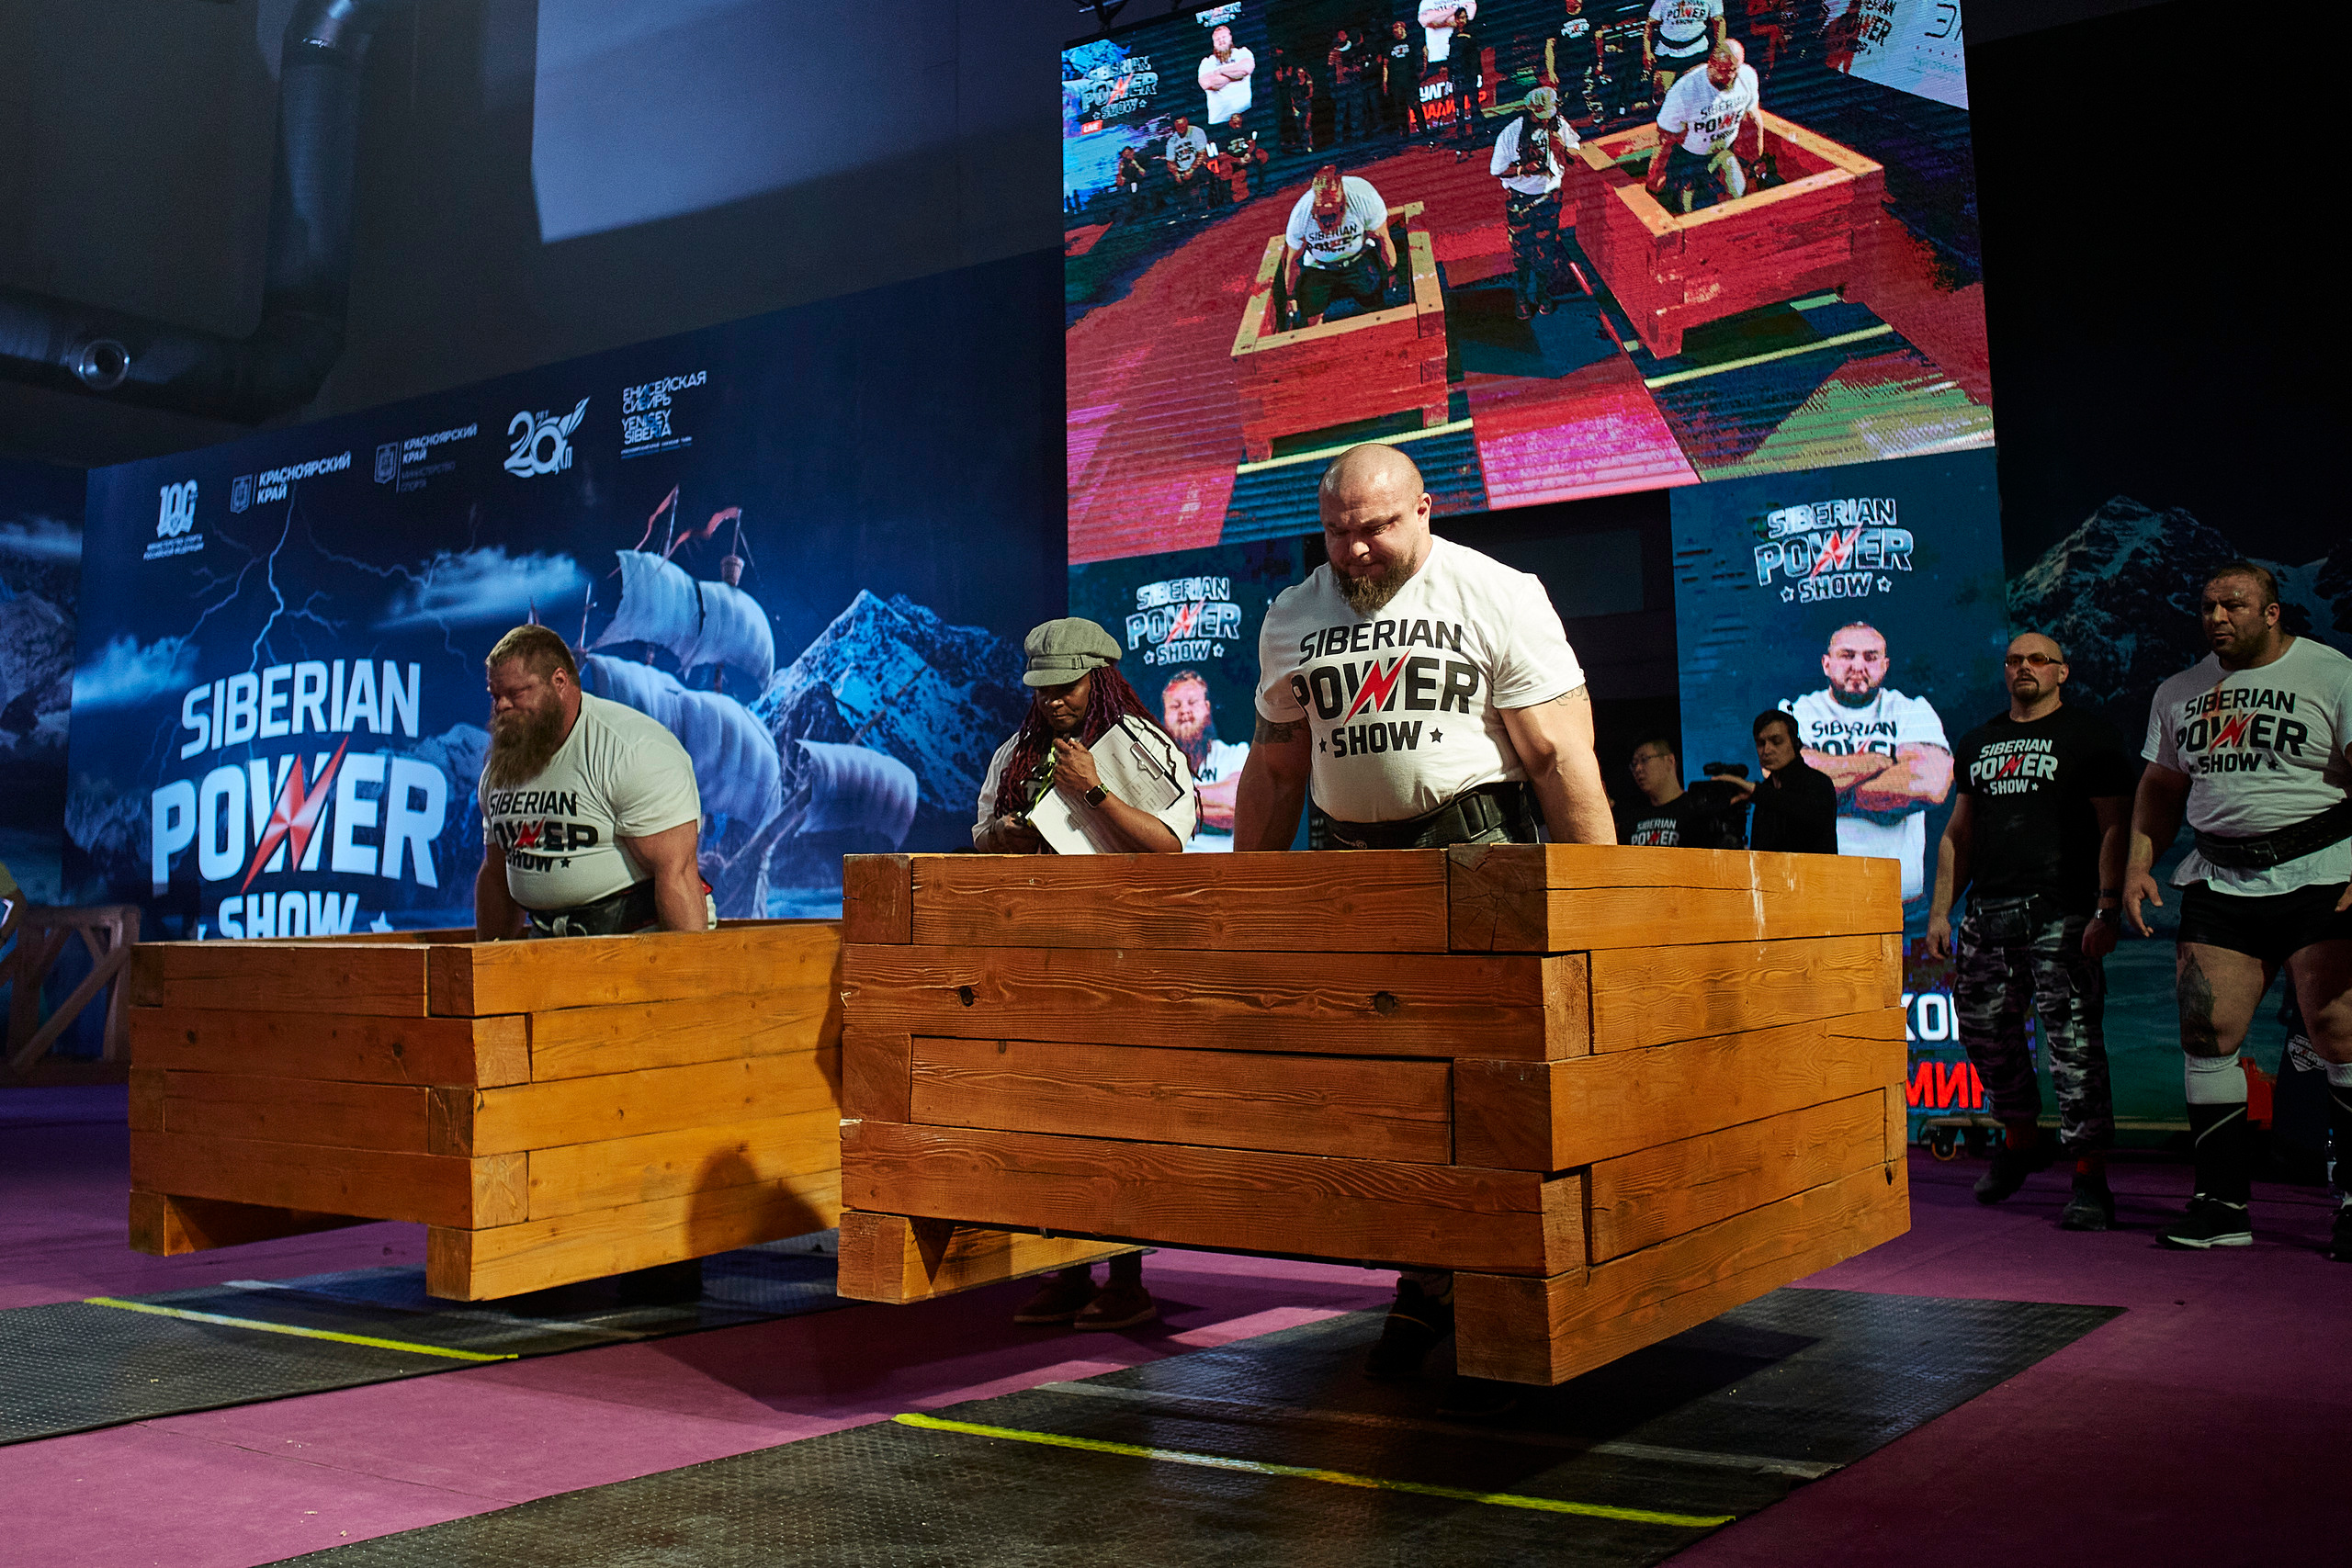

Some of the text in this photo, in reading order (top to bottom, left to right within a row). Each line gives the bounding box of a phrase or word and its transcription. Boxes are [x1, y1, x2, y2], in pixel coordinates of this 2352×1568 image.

[1080, 72, 1159, 112] POWER
[622, 370, 707, 402] ЕНИСЕЙСКАЯ
[623, 391, 673, 415] СИБИРЬ
[403, 423, 478, 452] КРАСНОЯРСКИЙ
[621, 409, 673, 432] YENISEY
[624, 423, 673, 446] SIBERIA
[258, 450, 352, 488] КРАСНОЯРСКИЙ
[402, 447, 427, 466] КРАЙ
[256, 482, 288, 505] КРАЙ
[1767, 498, 1898, 539] SIBERIAN
[1753, 526, 1914, 587] POWER
[1136, 576, 1230, 611] SIBERIAN
[1798, 571, 1873, 604] SHOW
[1125, 600, 1241, 651] POWER
[1299, 618, 1463, 666] SIBERIAN
[1156, 640, 1212, 666] SHOW
[1290, 652, 1479, 722] POWER
[2184, 687, 2296, 721] SIBERIAN
[180, 658, 422, 761] SIBERIAN
[1333, 720, 1423, 759] SHOW
[1980, 739, 2052, 759] SIBERIAN
[2176, 710, 2309, 757] POWER
[1969, 752, 2059, 787] POWER
[2200, 752, 2262, 775] SHOW
[489, 790, 578, 818] SIBERIAN
[1990, 778, 2029, 796] SHOW
[151, 749, 448, 898] POWER
[1631, 829, 1680, 846] POWER
[218, 890, 359, 940] SHOW
